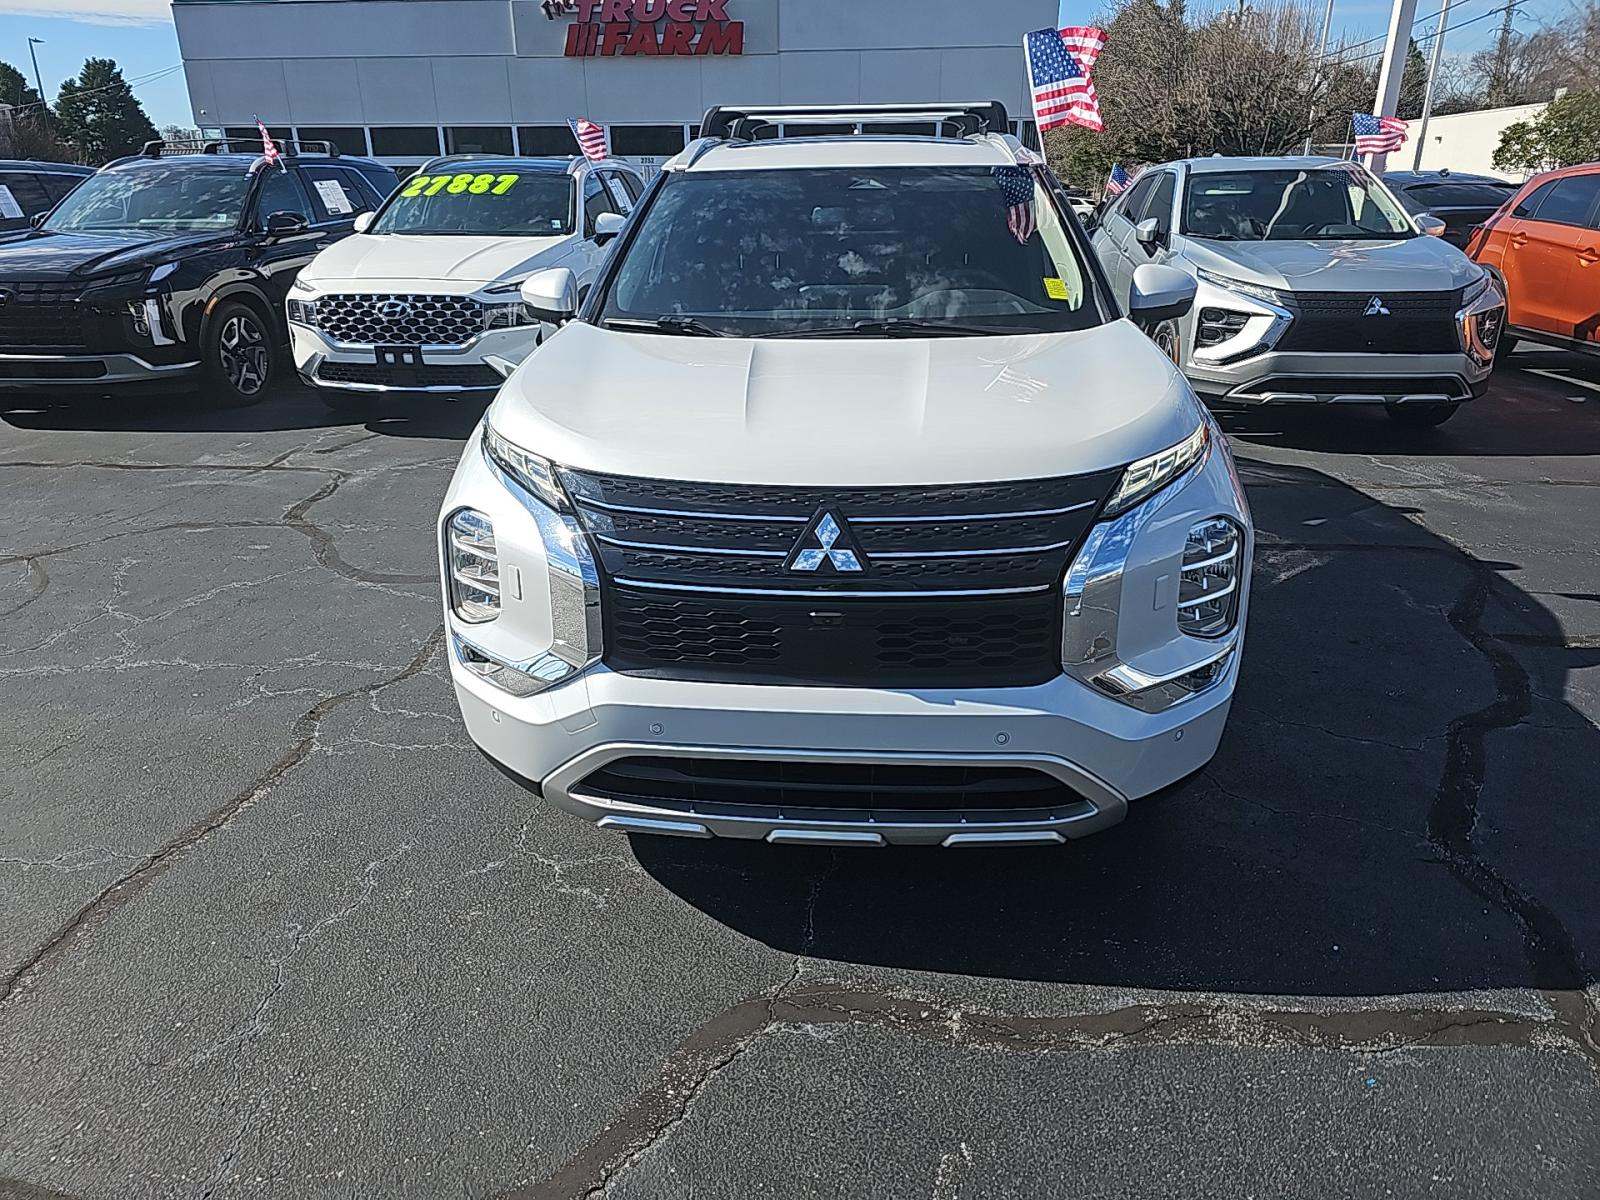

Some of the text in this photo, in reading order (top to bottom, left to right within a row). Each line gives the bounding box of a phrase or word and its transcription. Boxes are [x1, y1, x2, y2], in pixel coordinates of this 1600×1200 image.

[575, 0, 731, 23] TRUCK
[601, 21, 744, 56] FARM
[400, 173, 519, 197] 27887
